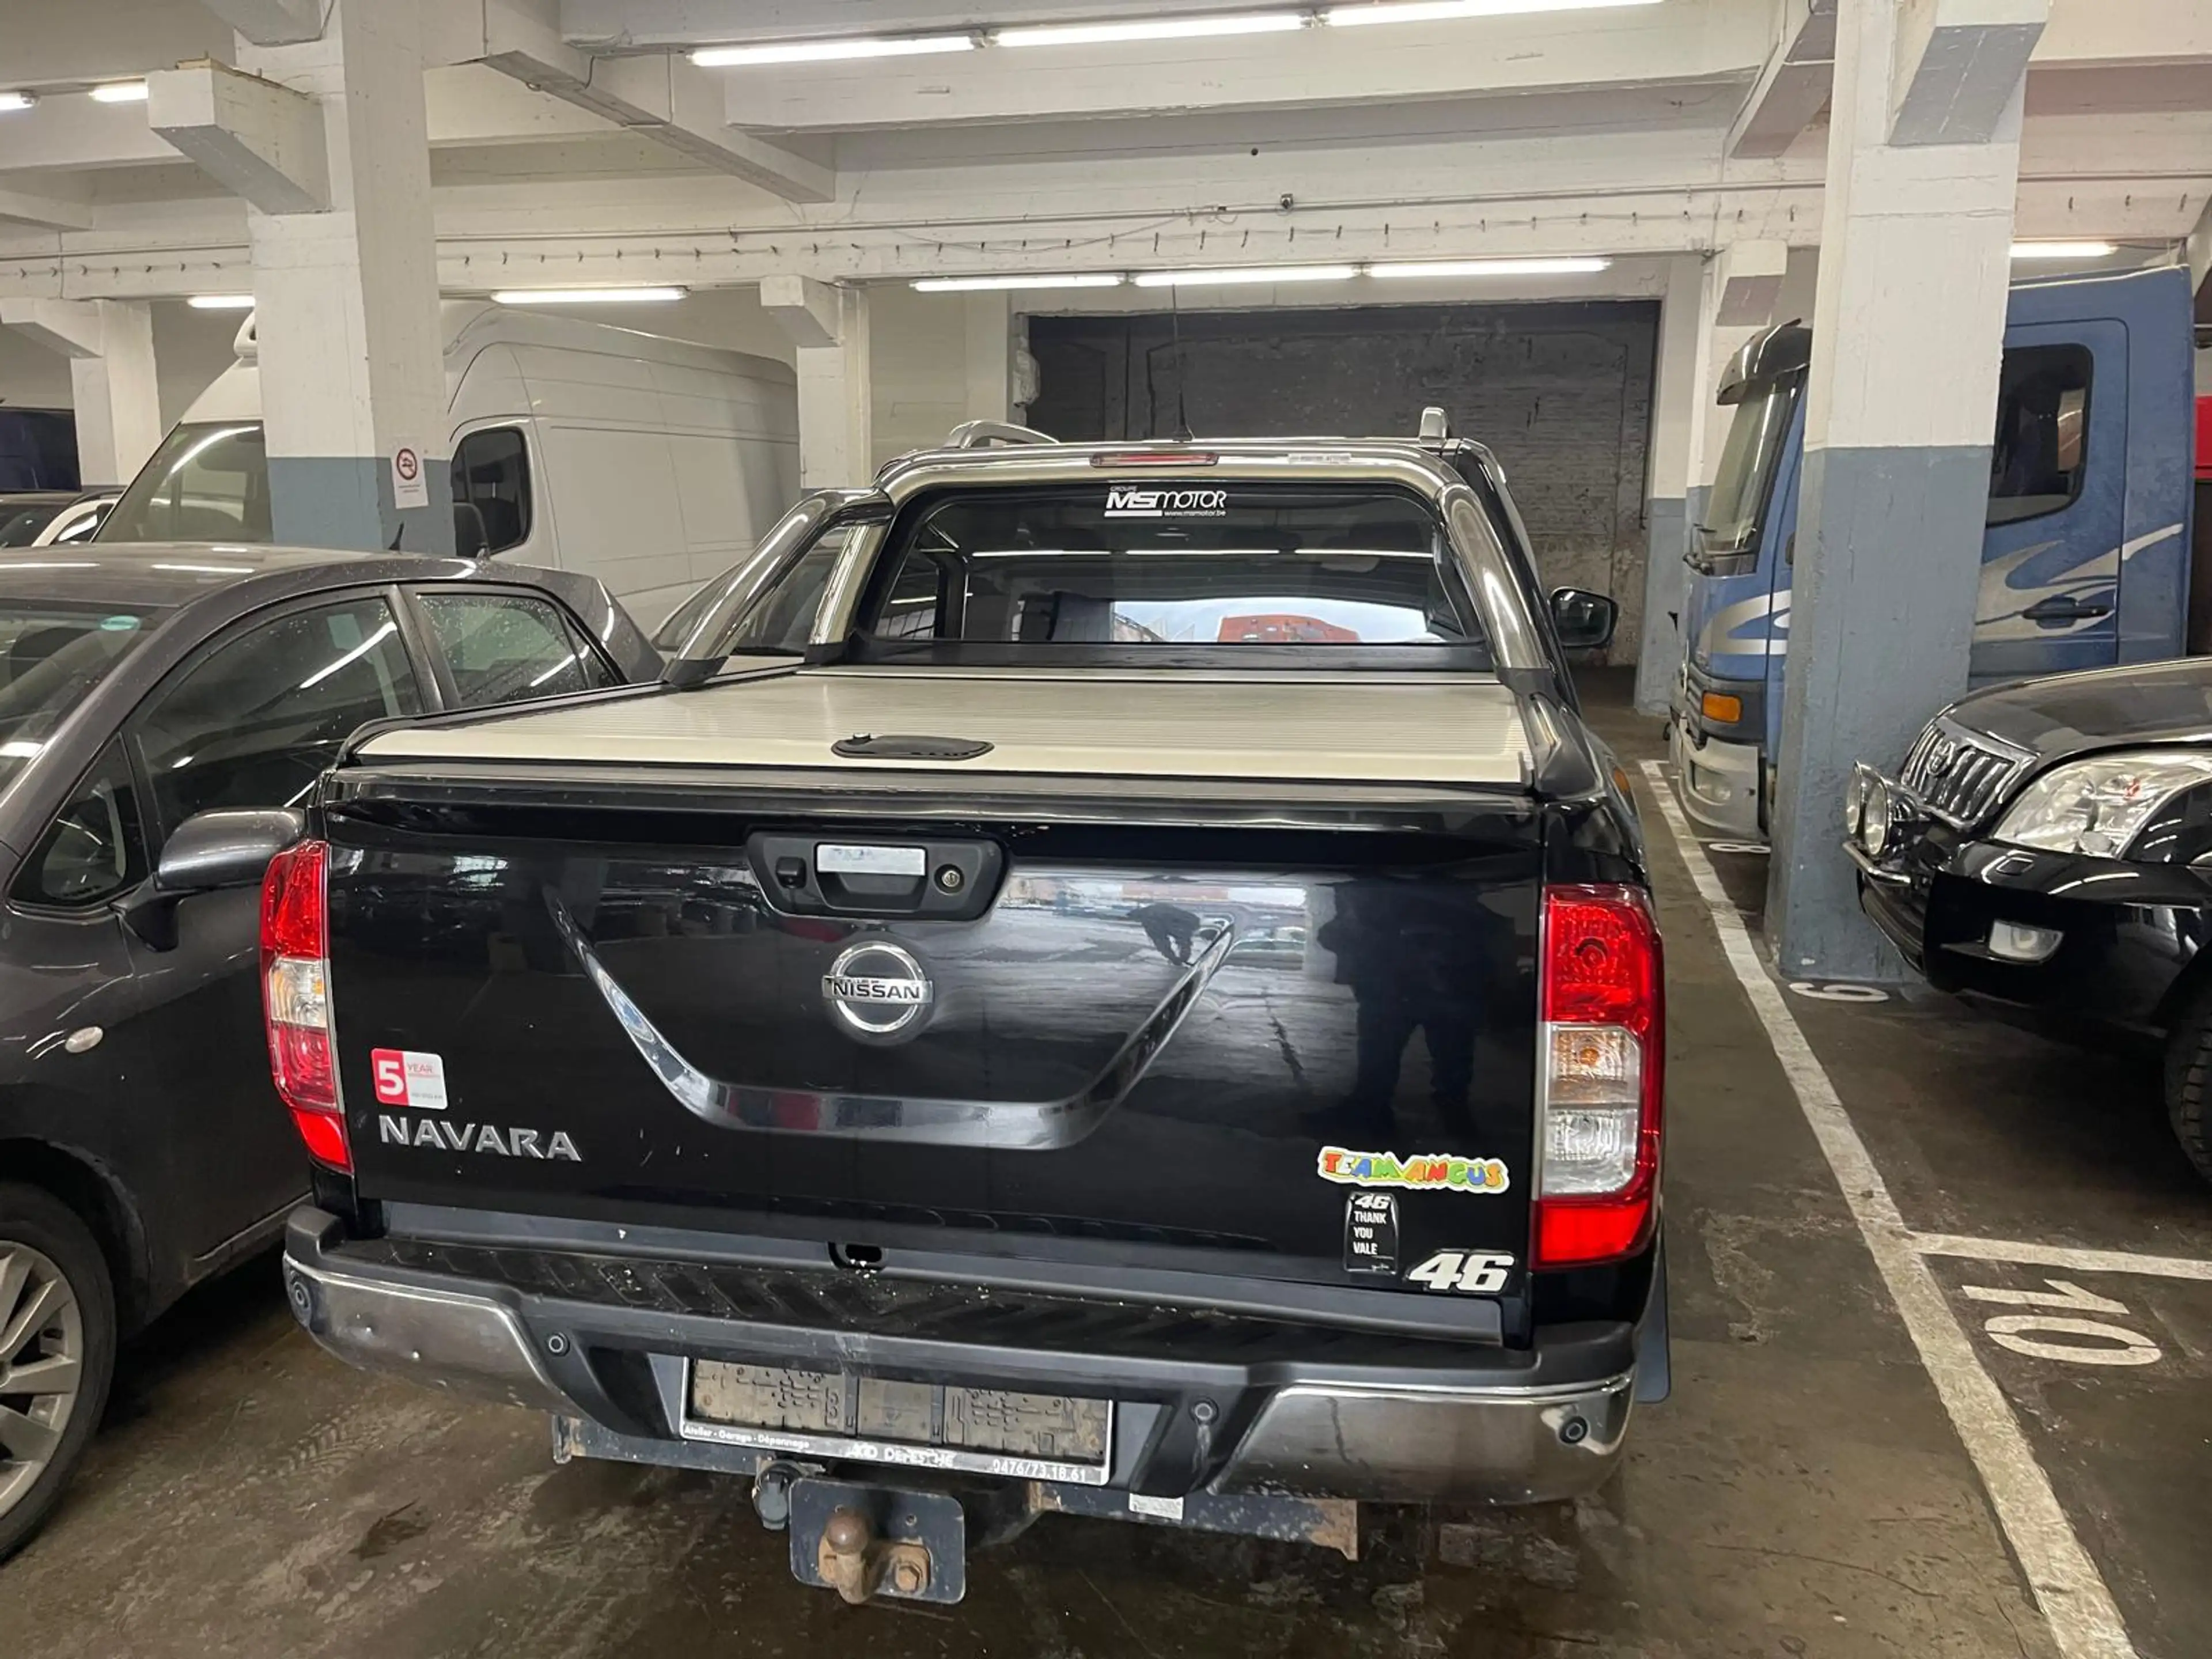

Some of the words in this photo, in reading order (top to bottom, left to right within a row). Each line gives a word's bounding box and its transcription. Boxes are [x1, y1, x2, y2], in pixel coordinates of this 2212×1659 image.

[833, 982, 920, 999] NISSAN
[378, 1060, 404, 1096] 5
[378, 1115, 582, 1162] NAVARA
[1355, 1194, 1392, 1209] 46
[1353, 1210, 1387, 1225] THANK
[1353, 1226, 1373, 1239] YOU
[1353, 1241, 1378, 1255] VALE
[1408, 1252, 1516, 1291] 46
[1961, 1278, 2162, 1366] 10
[684, 1425, 713, 1437] Atelier
[719, 1429, 752, 1443] Garage
